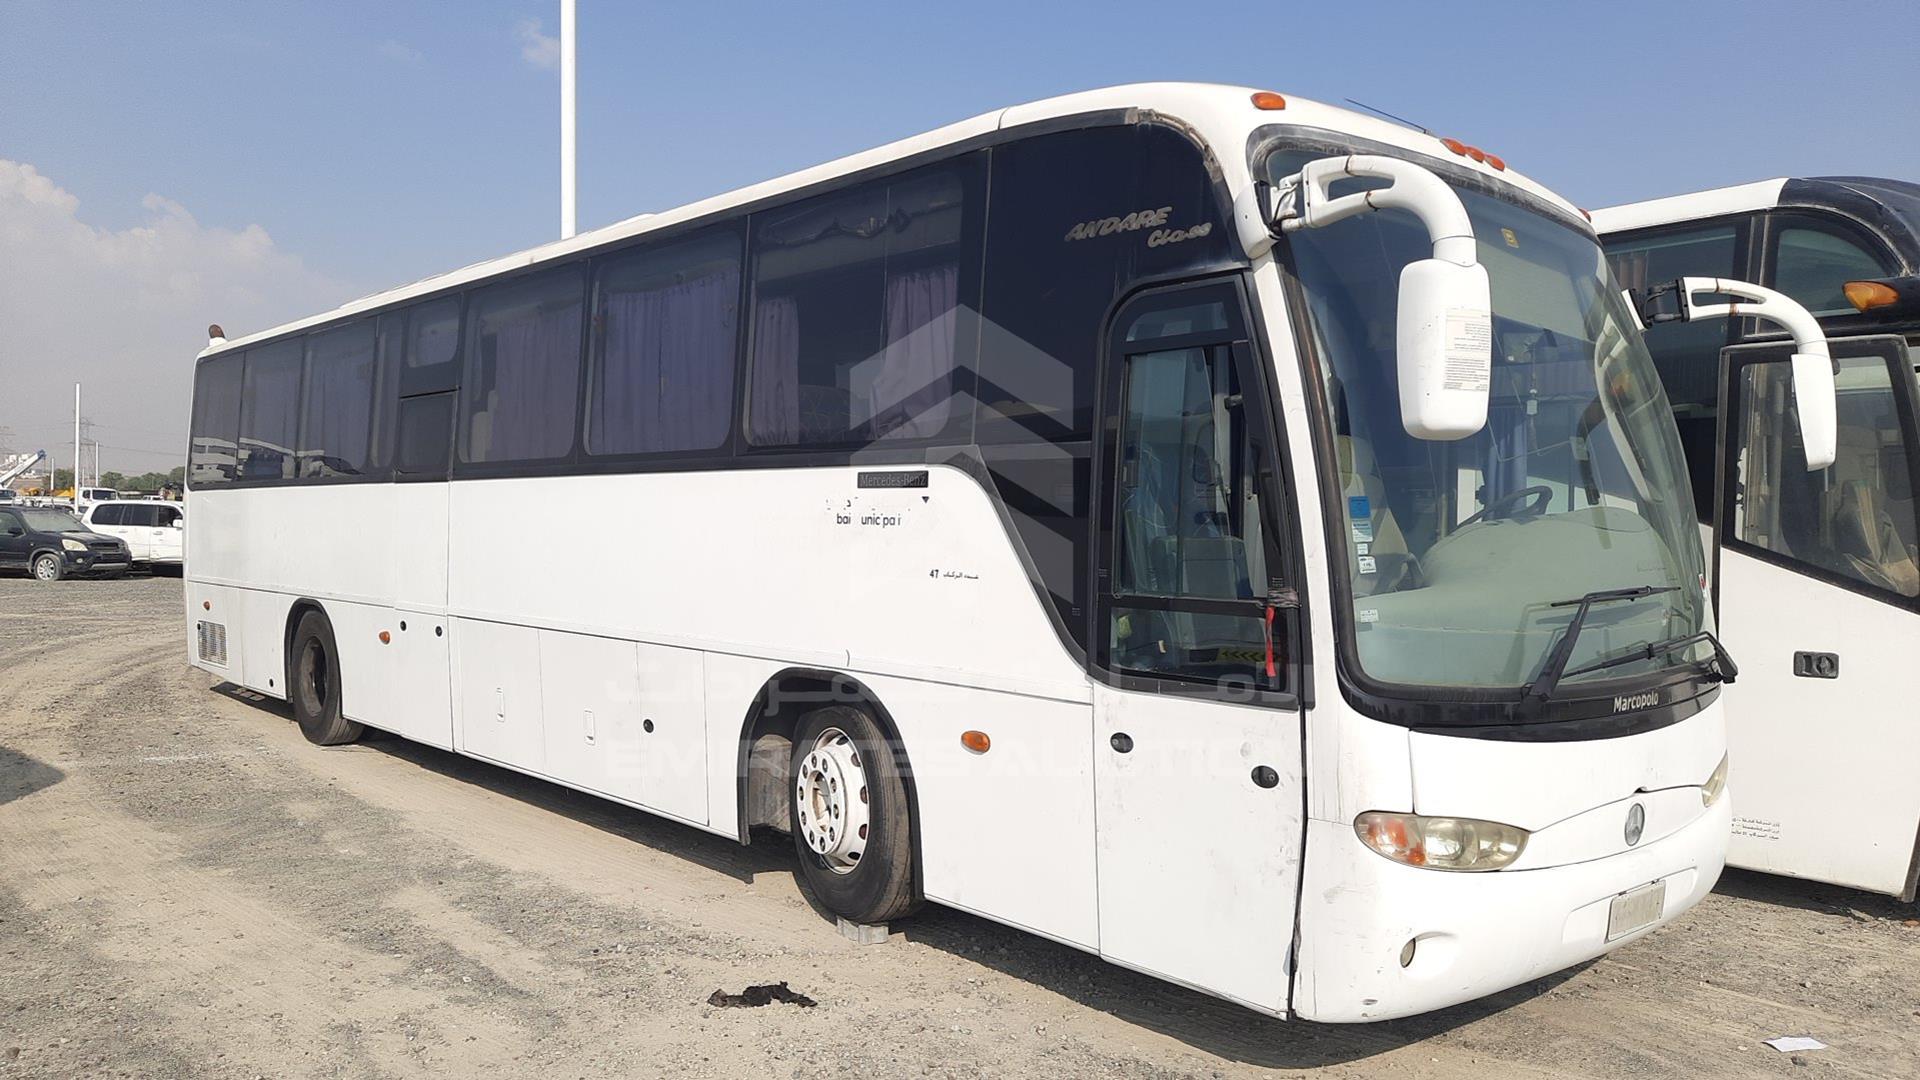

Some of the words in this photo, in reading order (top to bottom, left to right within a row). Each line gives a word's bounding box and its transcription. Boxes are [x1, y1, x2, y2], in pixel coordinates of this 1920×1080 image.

[1064, 206, 1172, 241] ANDARE
[861, 471, 926, 487] Mercedes-Benz
[929, 569, 939, 579] 47
[1613, 691, 1659, 713] Marcopolo
